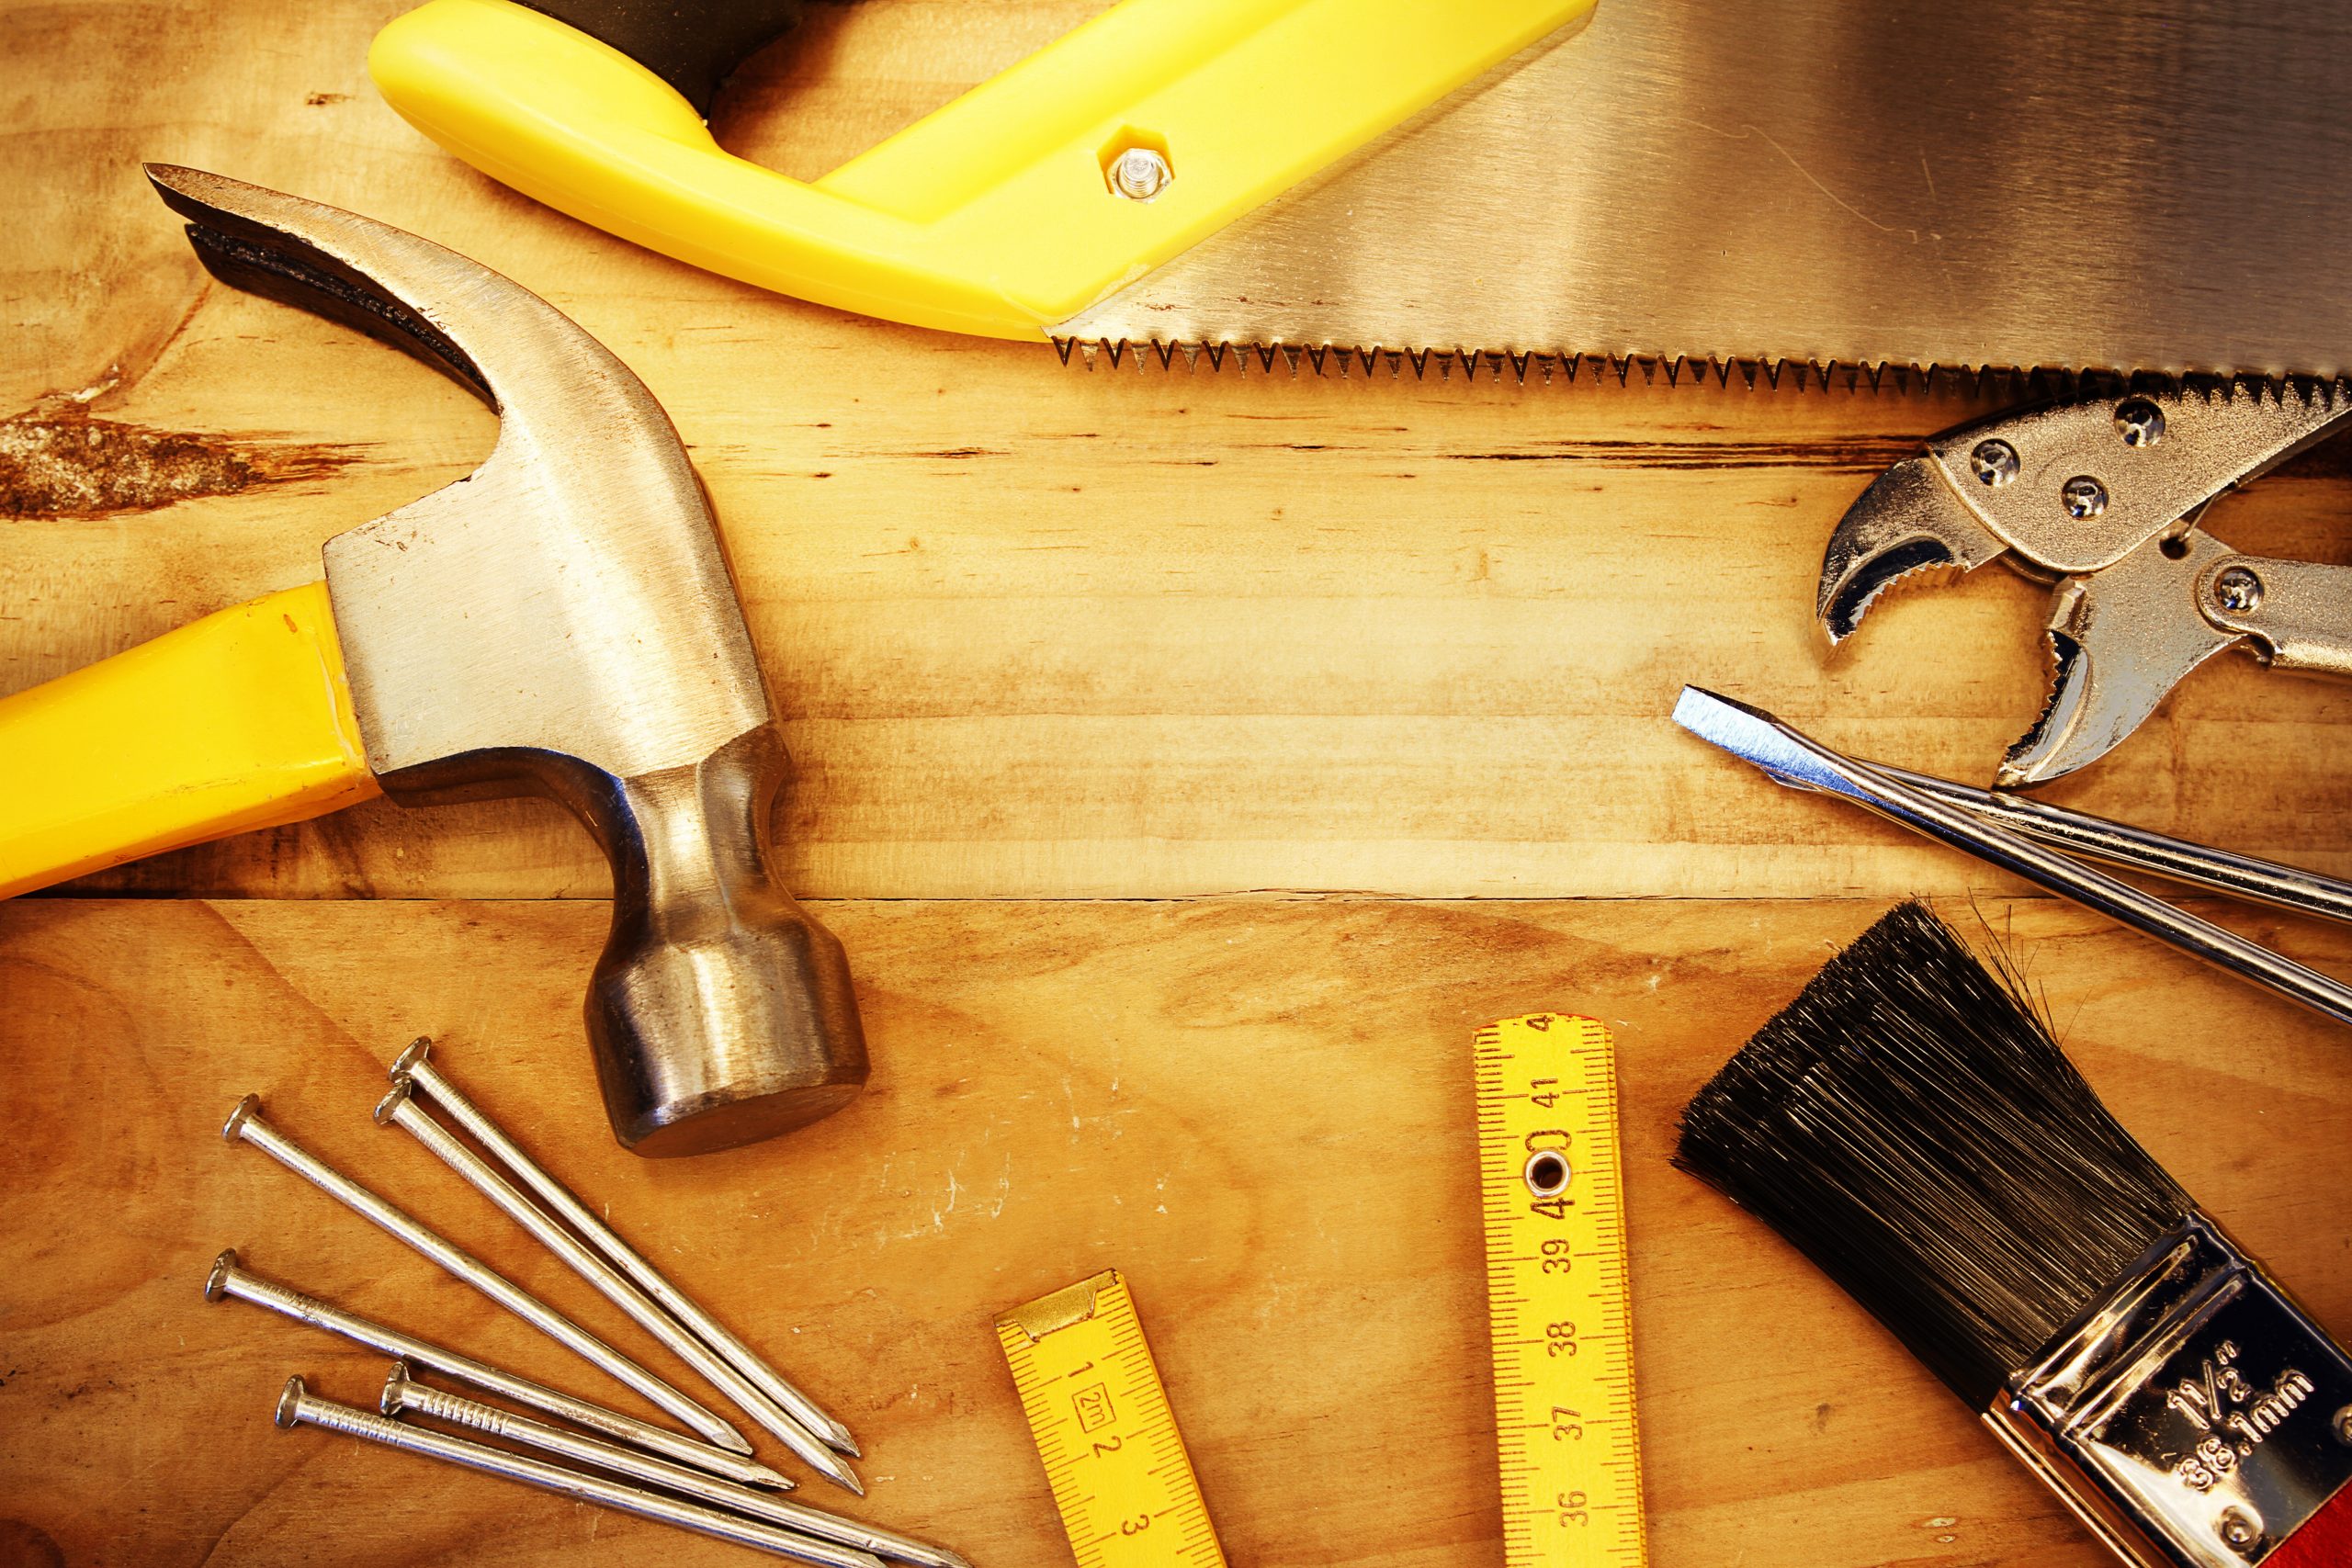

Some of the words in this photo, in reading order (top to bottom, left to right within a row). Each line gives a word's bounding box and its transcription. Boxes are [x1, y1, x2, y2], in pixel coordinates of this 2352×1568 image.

[1531, 1077, 1560, 1108] 41
[1524, 1129, 1575, 1220] 40
[1541, 1238, 1572, 1274] 39
[1546, 1321, 1577, 1358] 38
[1068, 1360, 1094, 1378] 1
[1079, 1391, 1106, 1426] 2m
[1553, 1405, 1583, 1441] 37
[1091, 1435, 1122, 1459] 2
[1121, 1514, 1149, 1536] 3
[1557, 1490, 1589, 1528] 36
